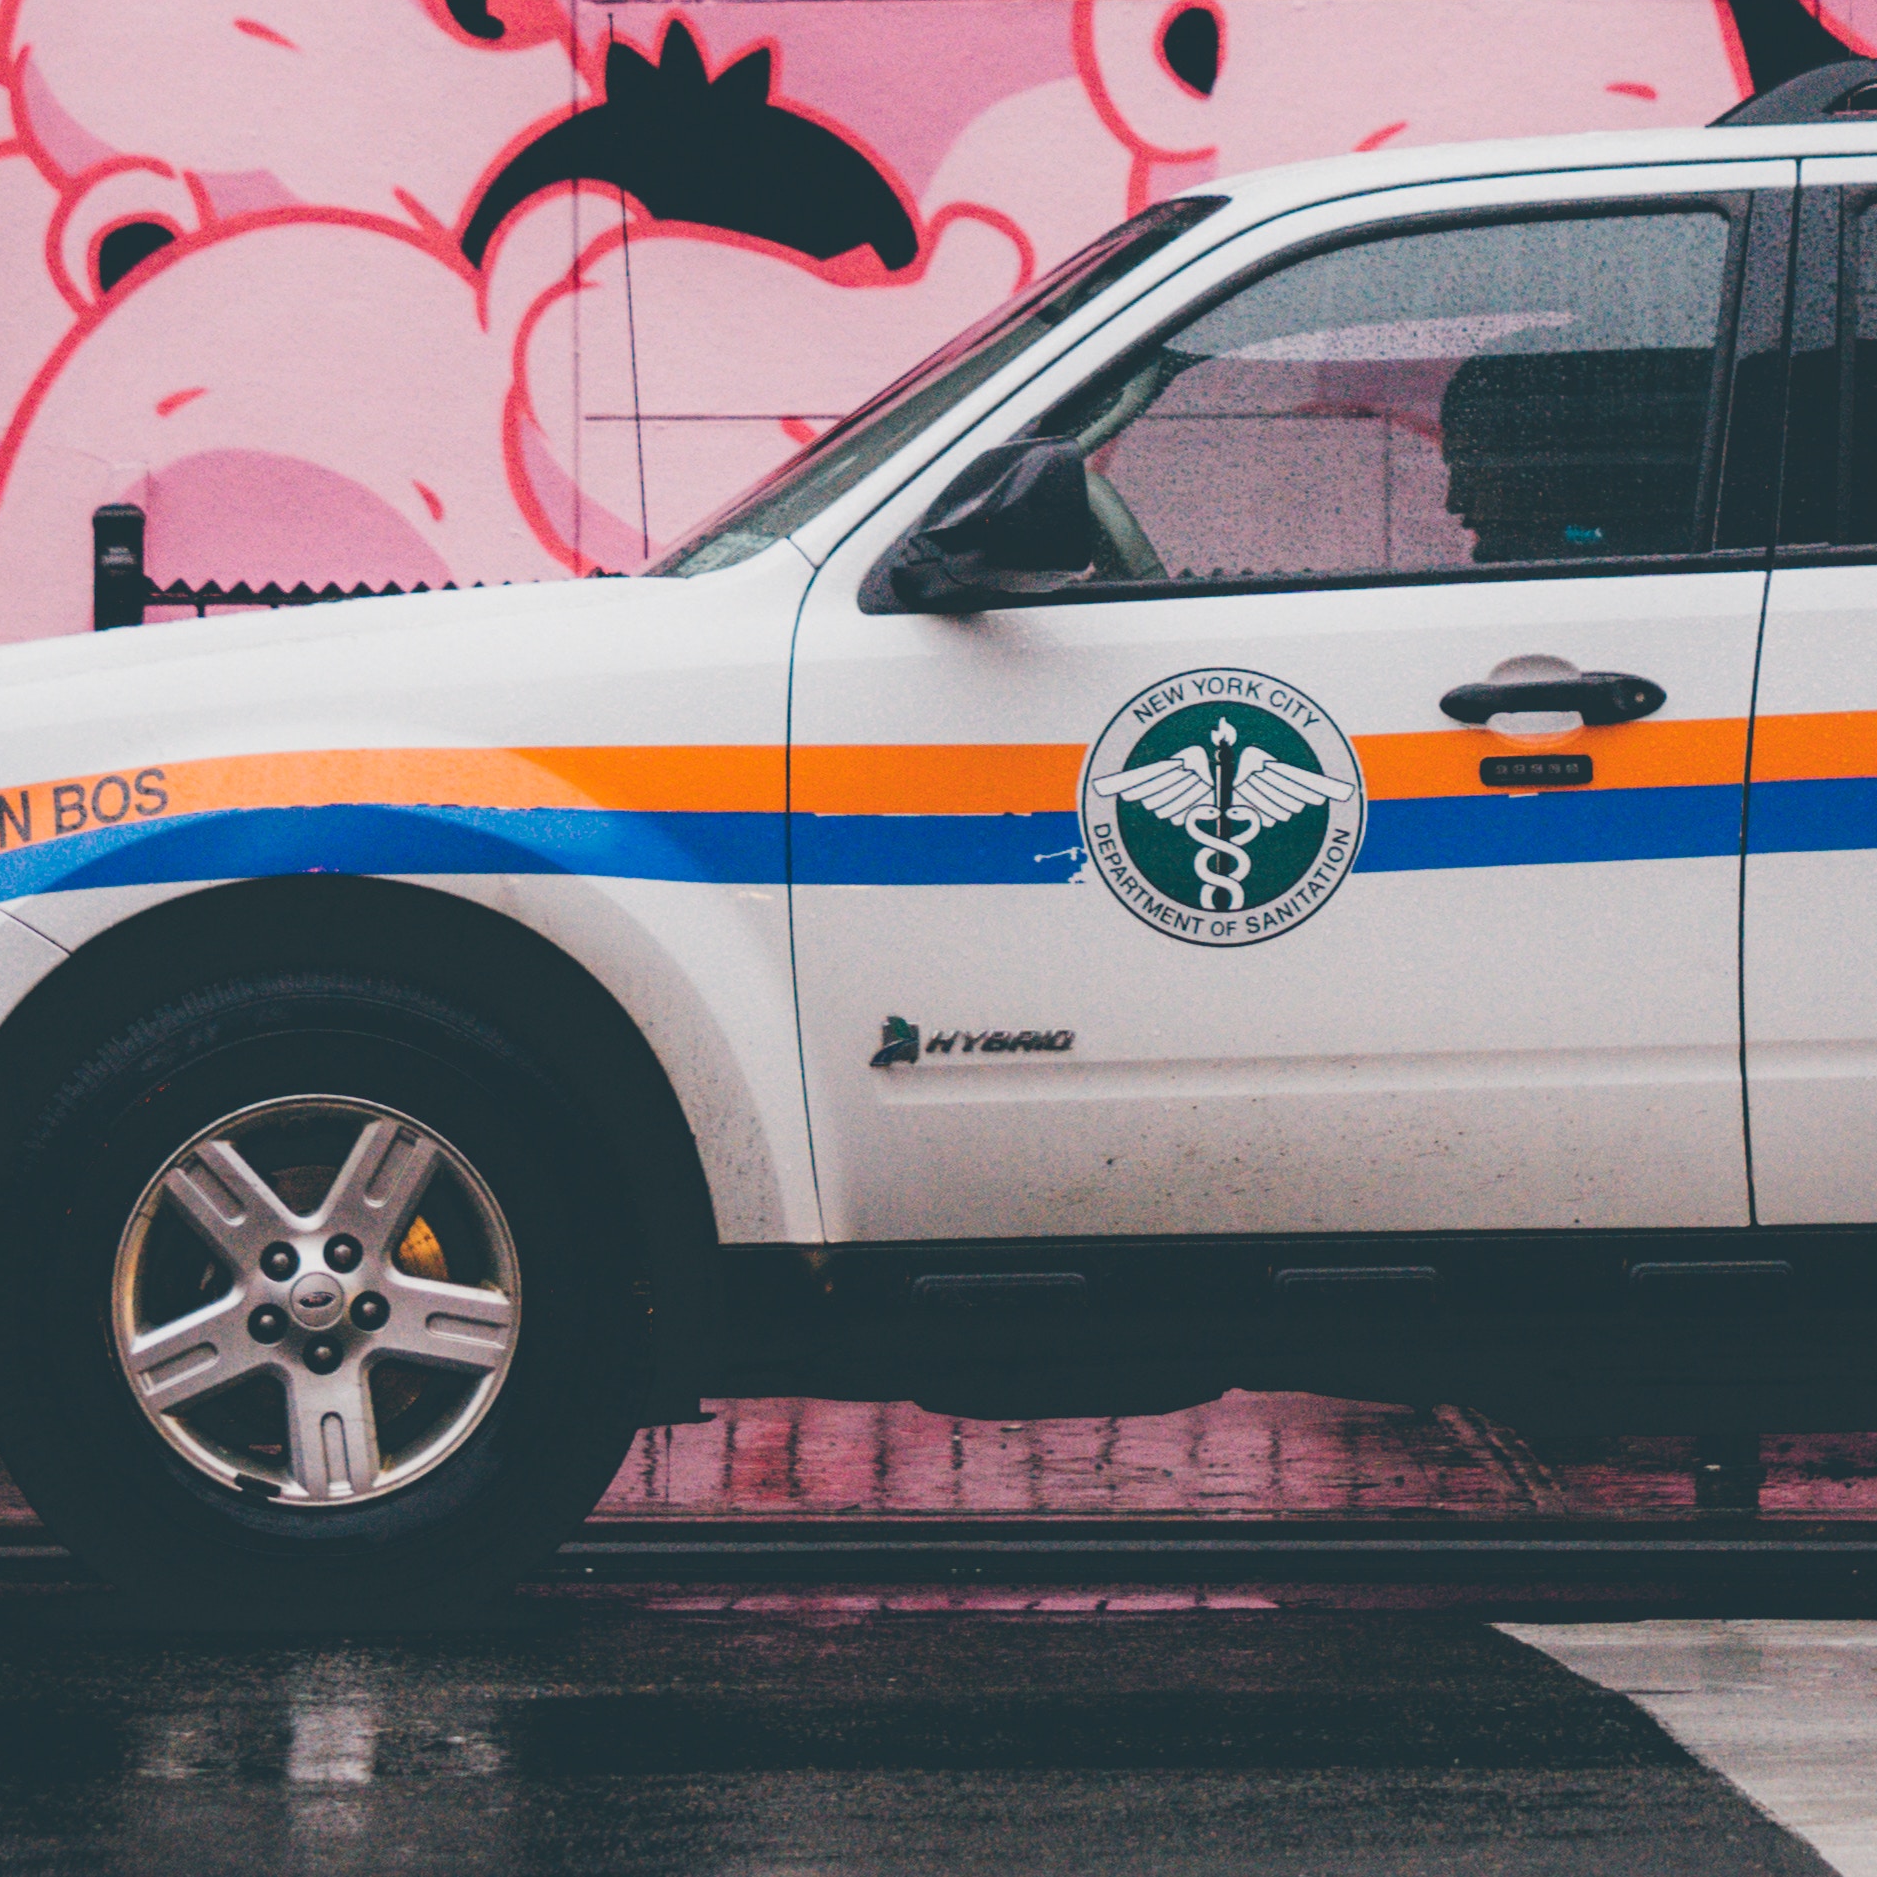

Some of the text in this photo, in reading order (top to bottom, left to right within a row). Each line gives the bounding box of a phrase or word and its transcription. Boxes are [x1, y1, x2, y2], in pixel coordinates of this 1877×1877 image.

[1132, 677, 1321, 729] NEW YORK CITY
[52, 768, 169, 835] BOS
[1093, 822, 1352, 938] DEPARTMENT OF SANITATION
[925, 1029, 1076, 1054] HYBRID
